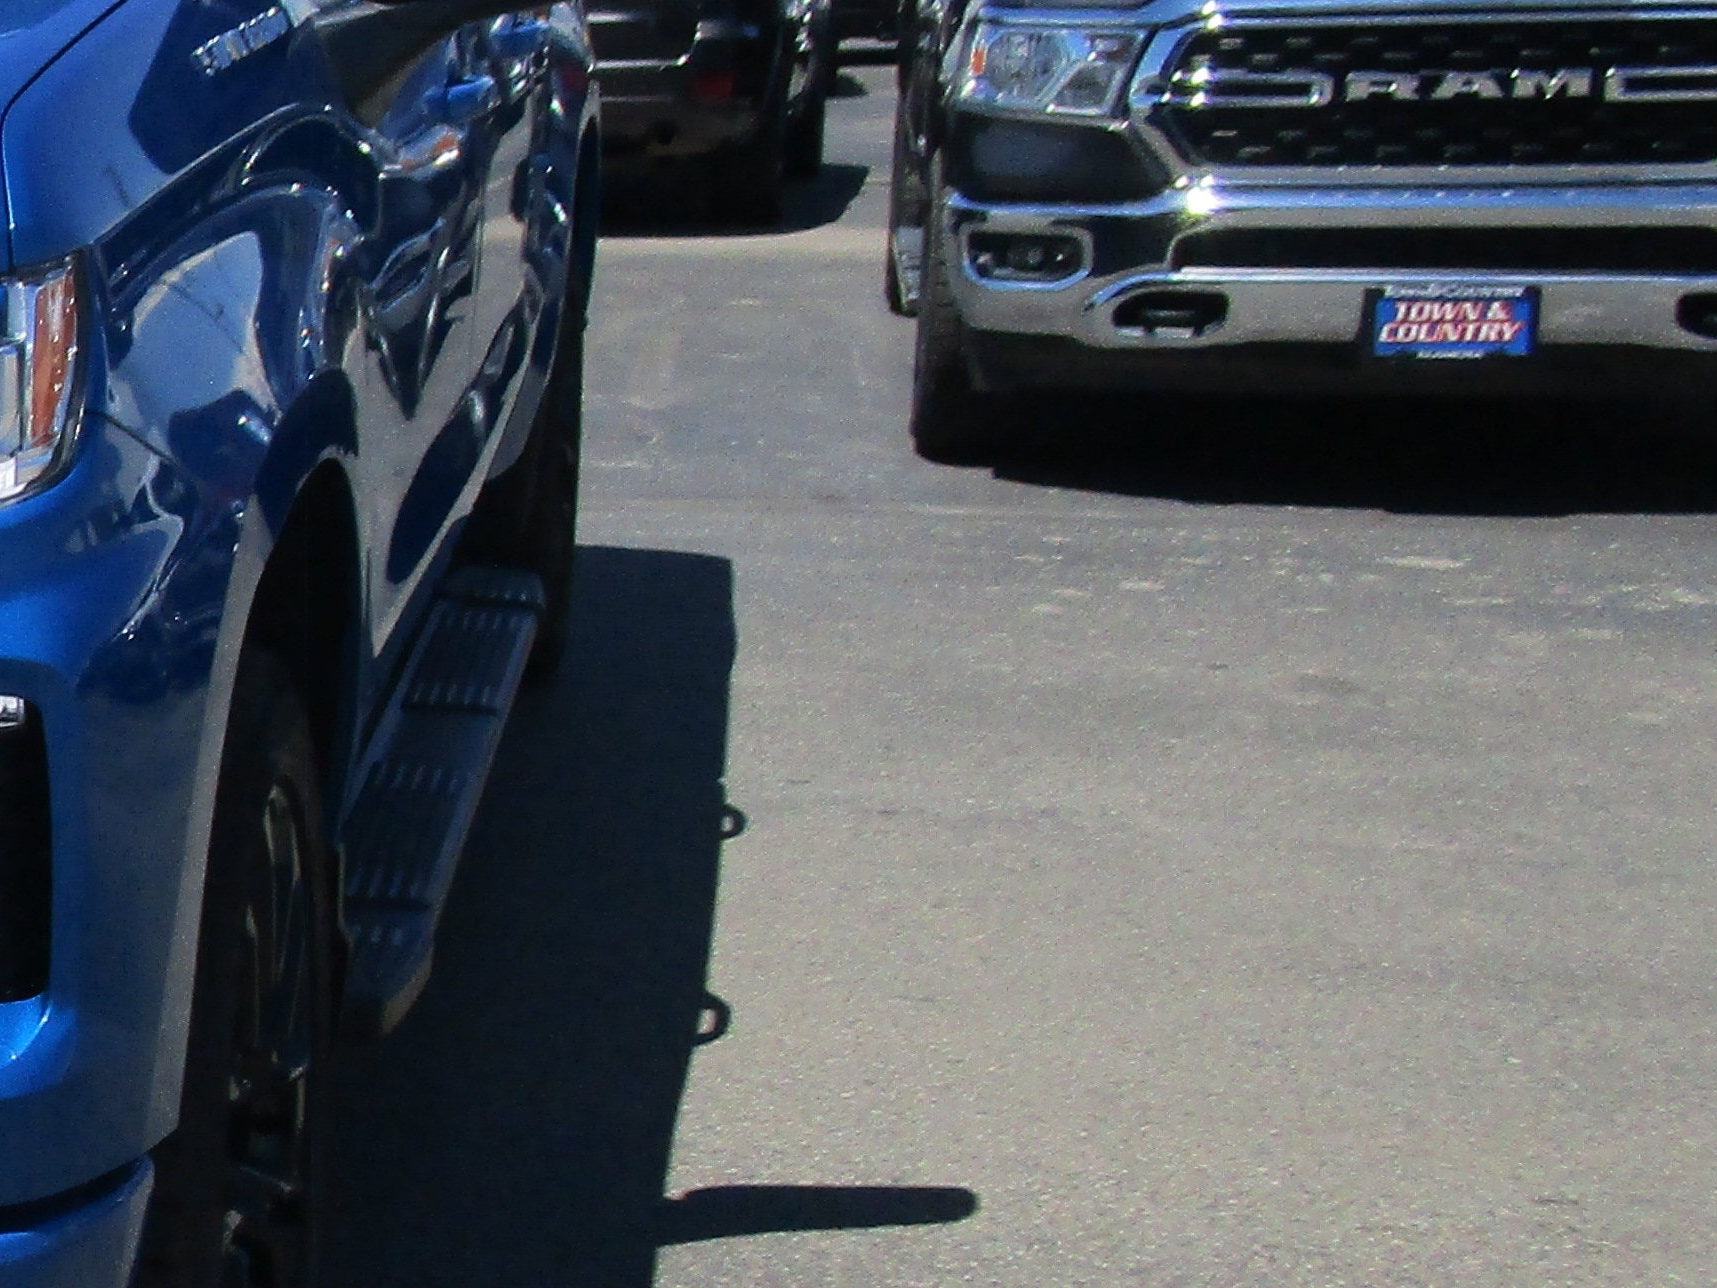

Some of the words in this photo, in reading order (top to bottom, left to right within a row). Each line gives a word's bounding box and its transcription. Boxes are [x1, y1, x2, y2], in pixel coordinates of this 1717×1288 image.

[1345, 68, 1593, 101] RAM
[1395, 300, 1484, 322] TOWN
[1487, 300, 1513, 322] &
[1378, 321, 1524, 343] COUNTRY
